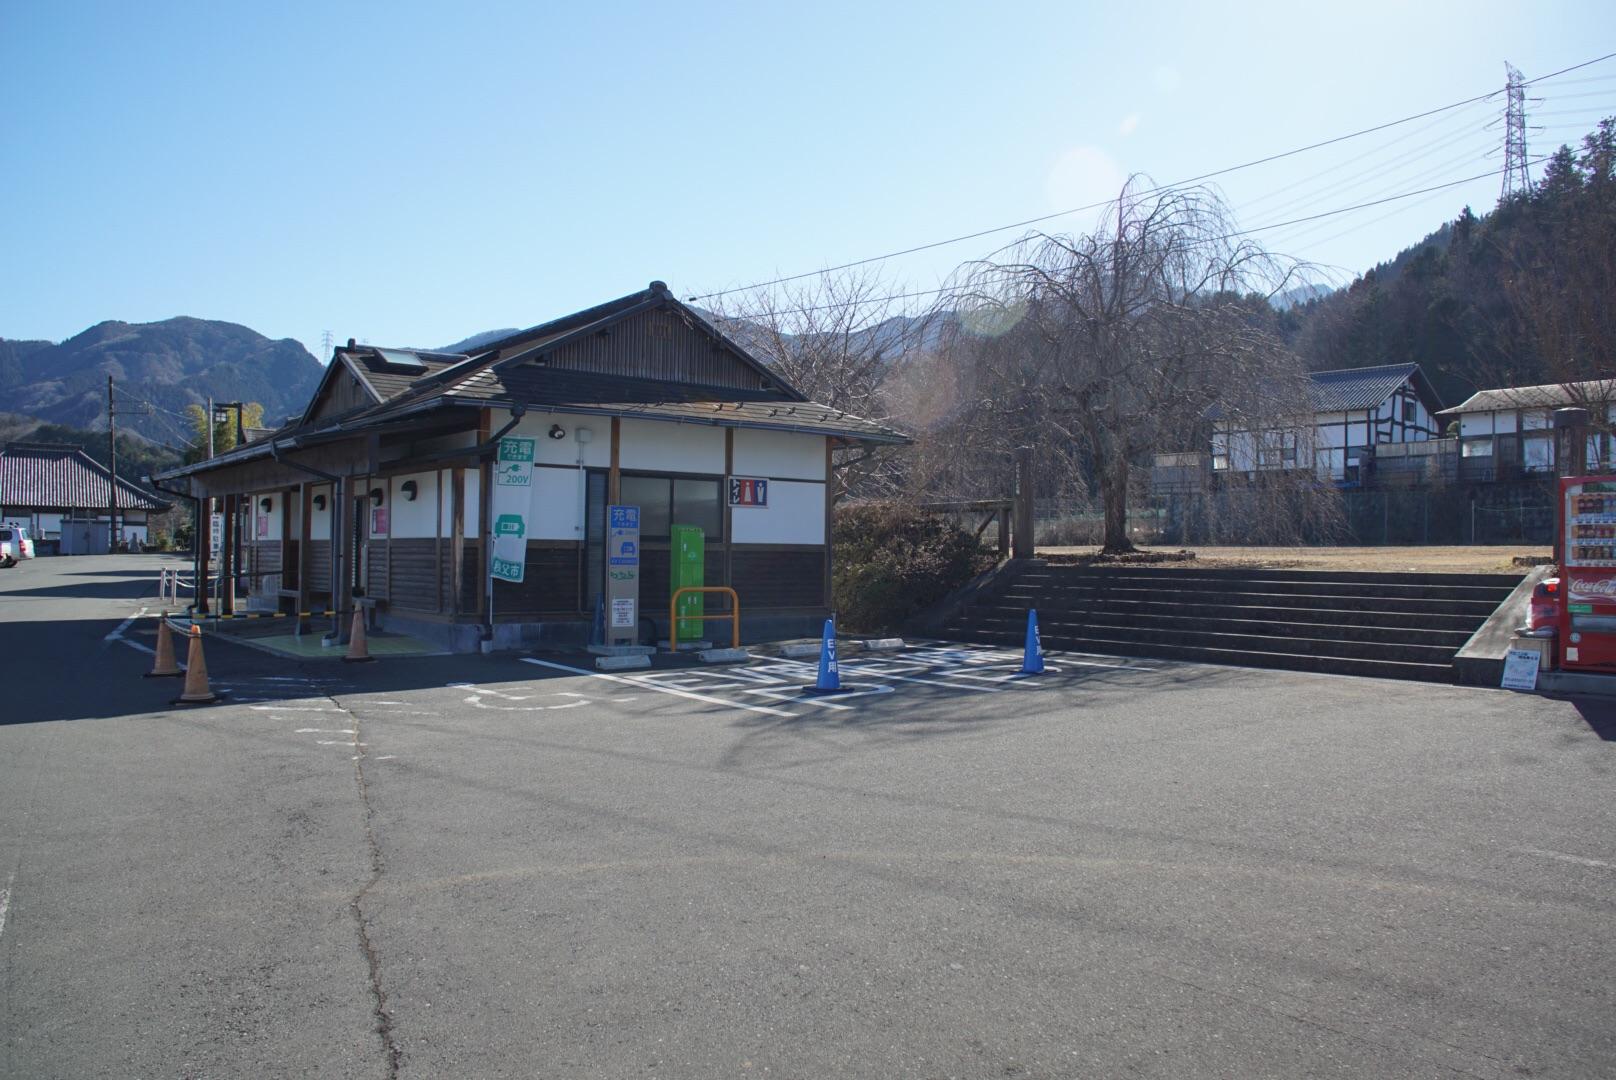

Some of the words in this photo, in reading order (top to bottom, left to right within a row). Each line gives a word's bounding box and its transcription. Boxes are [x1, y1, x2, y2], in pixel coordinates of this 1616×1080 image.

[503, 440, 532, 455] 充電
[506, 474, 529, 484] 200V
[732, 478, 740, 504] トイレ
[613, 508, 636, 522] 充電
[827, 638, 837, 673] EV用
